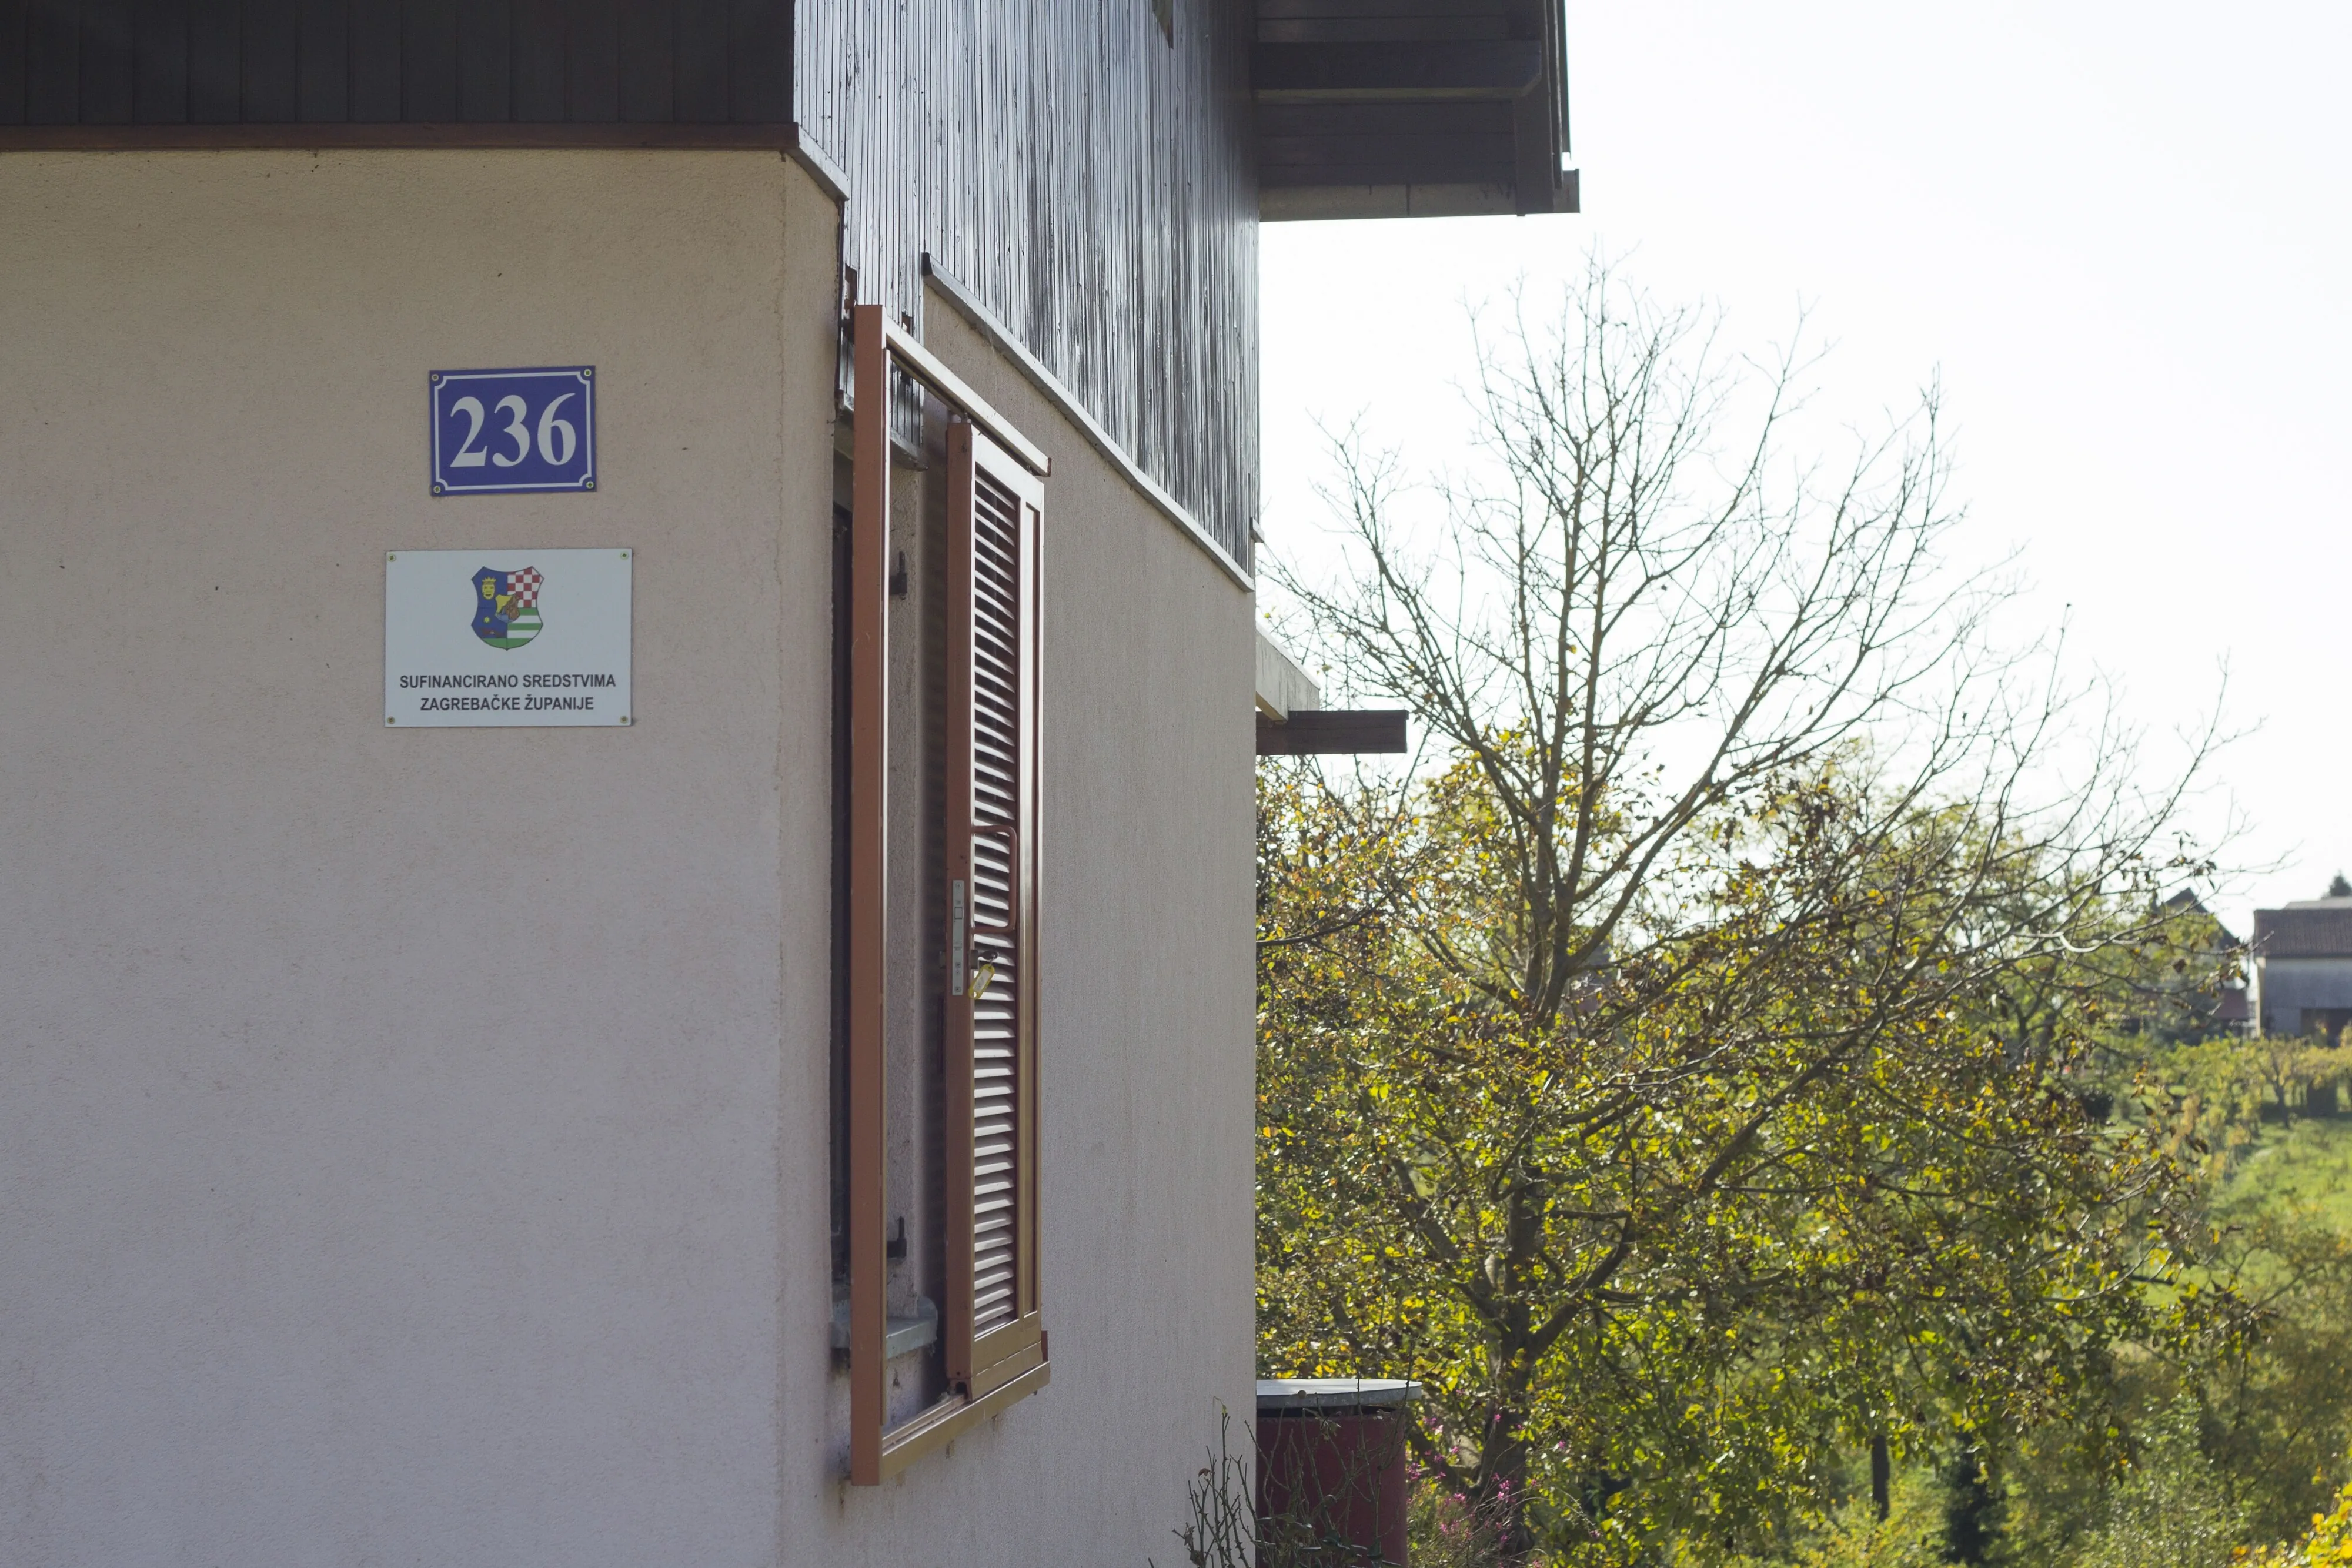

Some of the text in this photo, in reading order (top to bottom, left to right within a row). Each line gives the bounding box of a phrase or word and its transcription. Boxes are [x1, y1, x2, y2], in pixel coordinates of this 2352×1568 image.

[450, 392, 576, 467] 236
[400, 674, 616, 689] SUFINANCIRANO SREDSTVIMA
[420, 693, 594, 711] ZAGREBAČKE ŽUPANIJE
